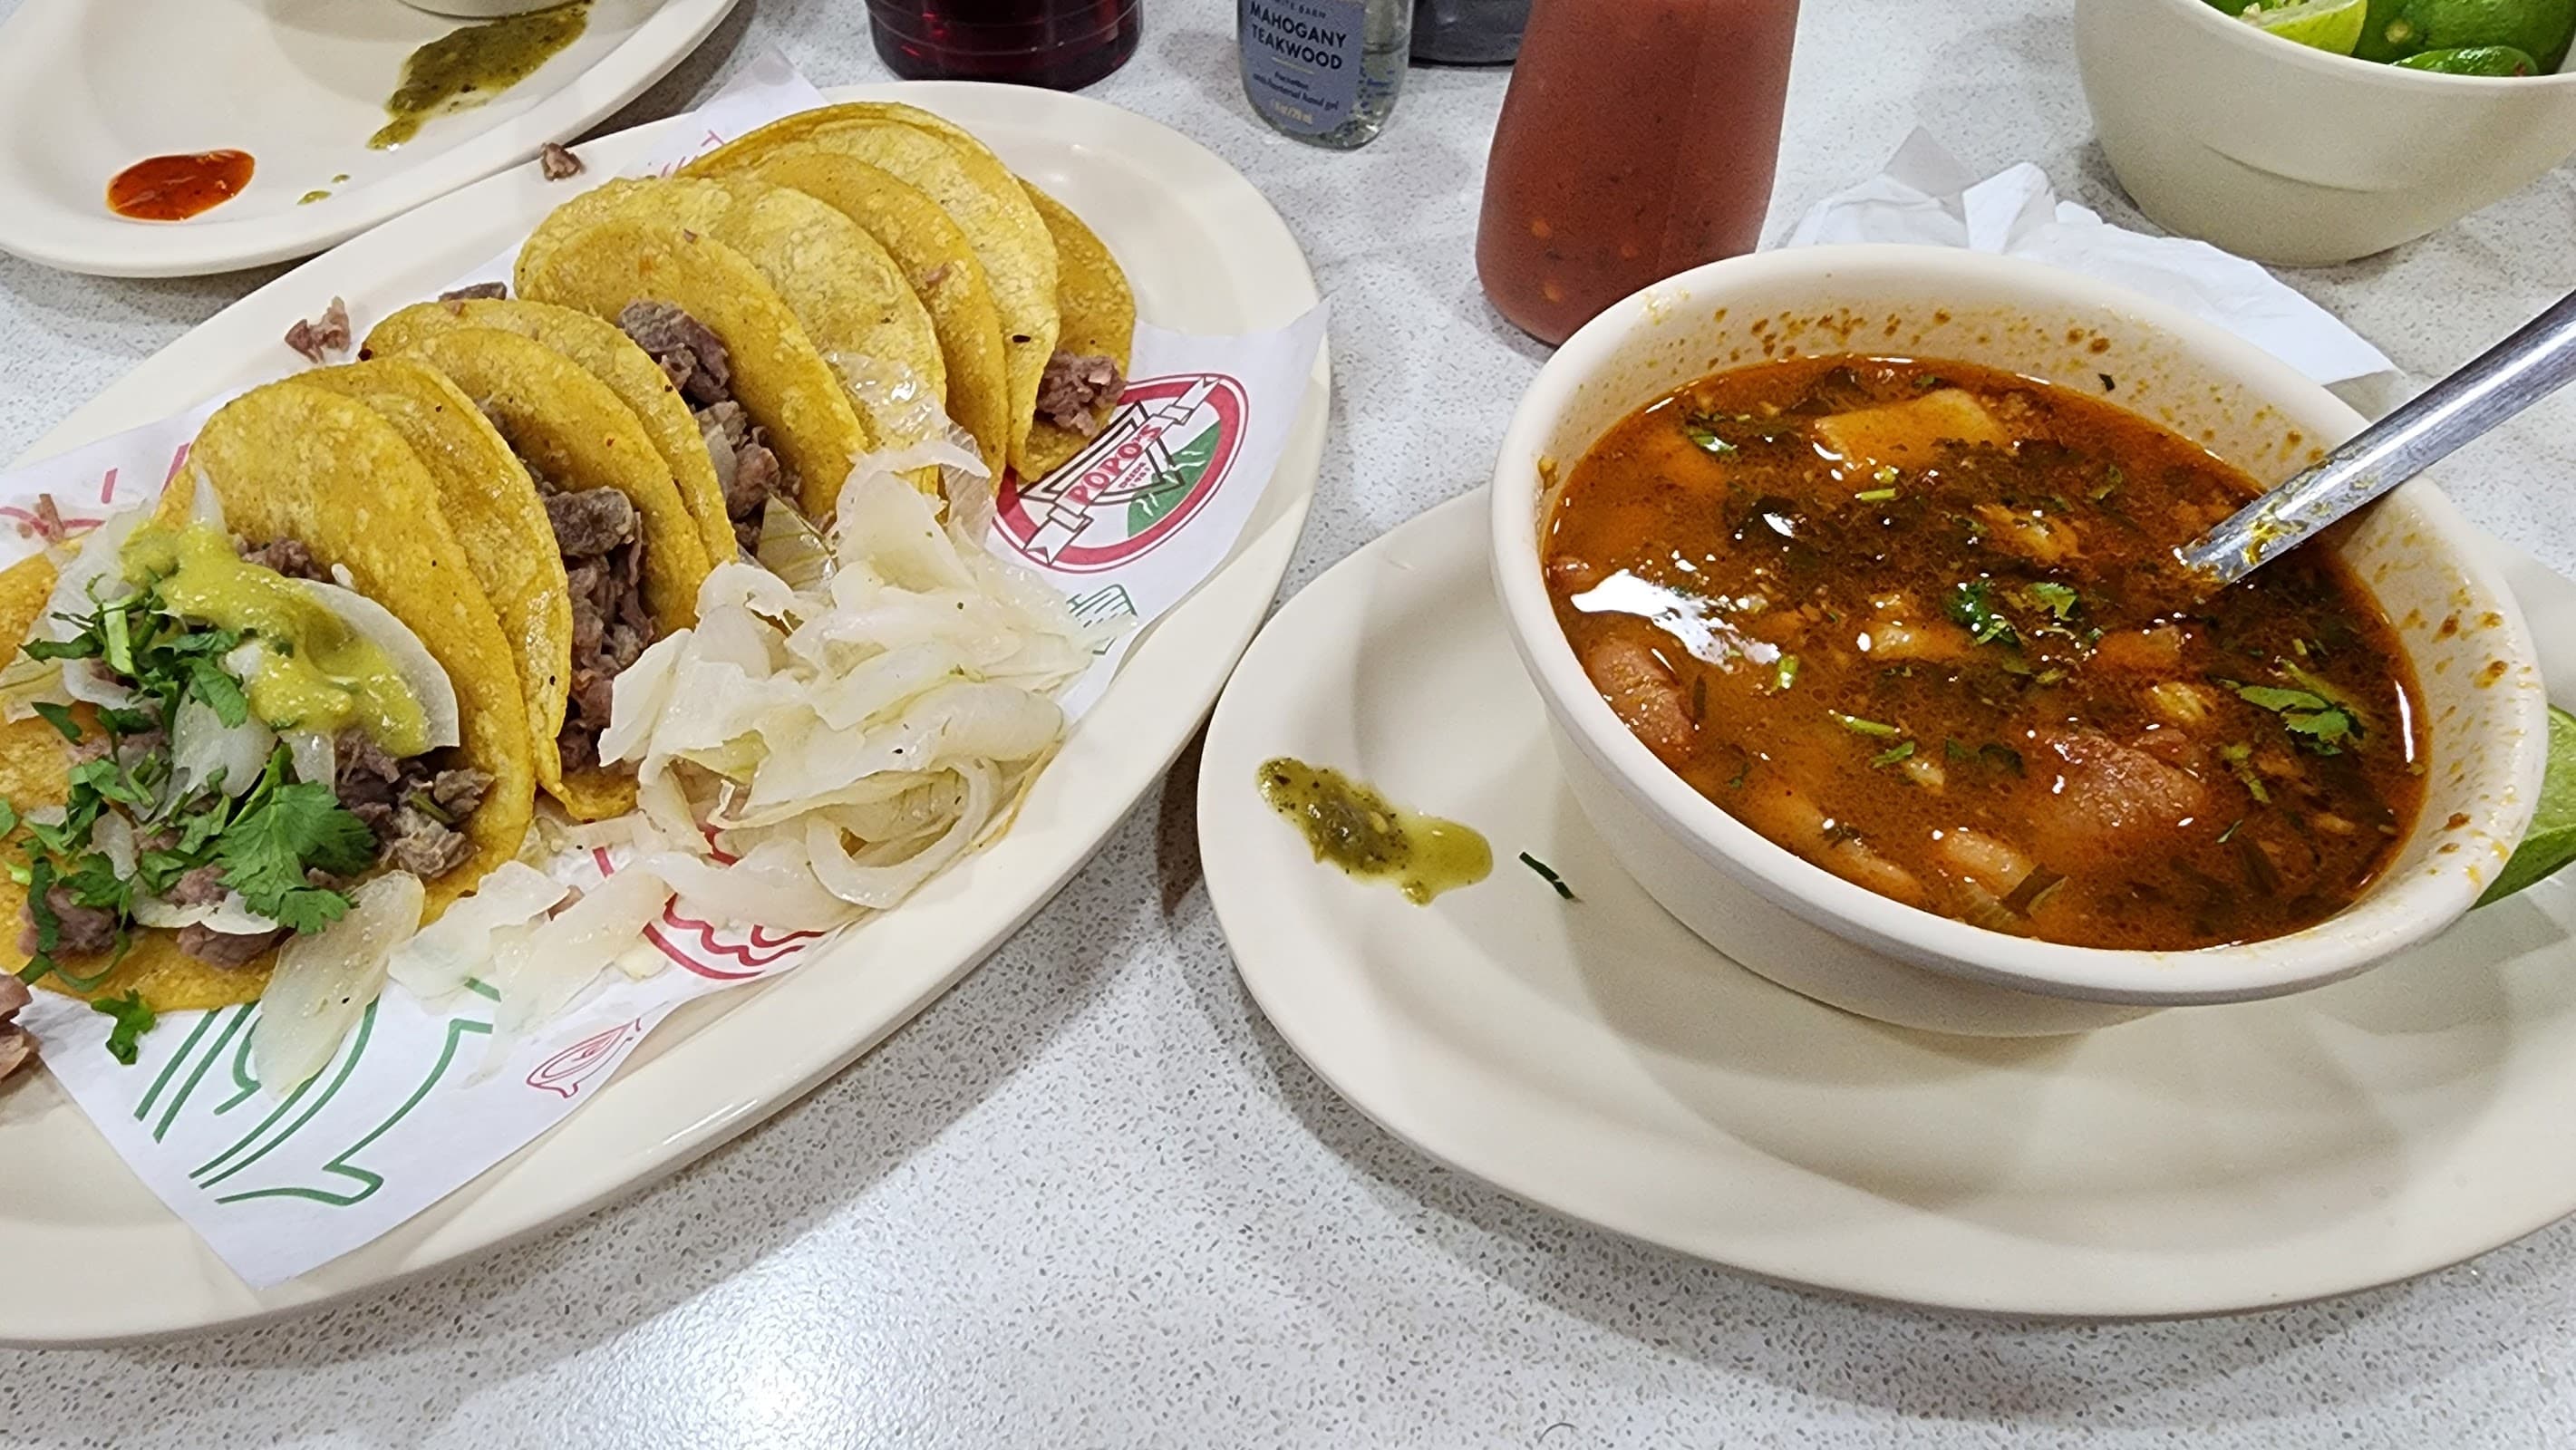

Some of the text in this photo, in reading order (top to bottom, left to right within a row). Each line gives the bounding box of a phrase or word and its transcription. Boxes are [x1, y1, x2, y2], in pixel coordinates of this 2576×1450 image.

[1250, 1, 1347, 48] MAHOGANY
[1252, 24, 1342, 69] TEAKWOOD
[1066, 424, 1163, 505] POPO'S
